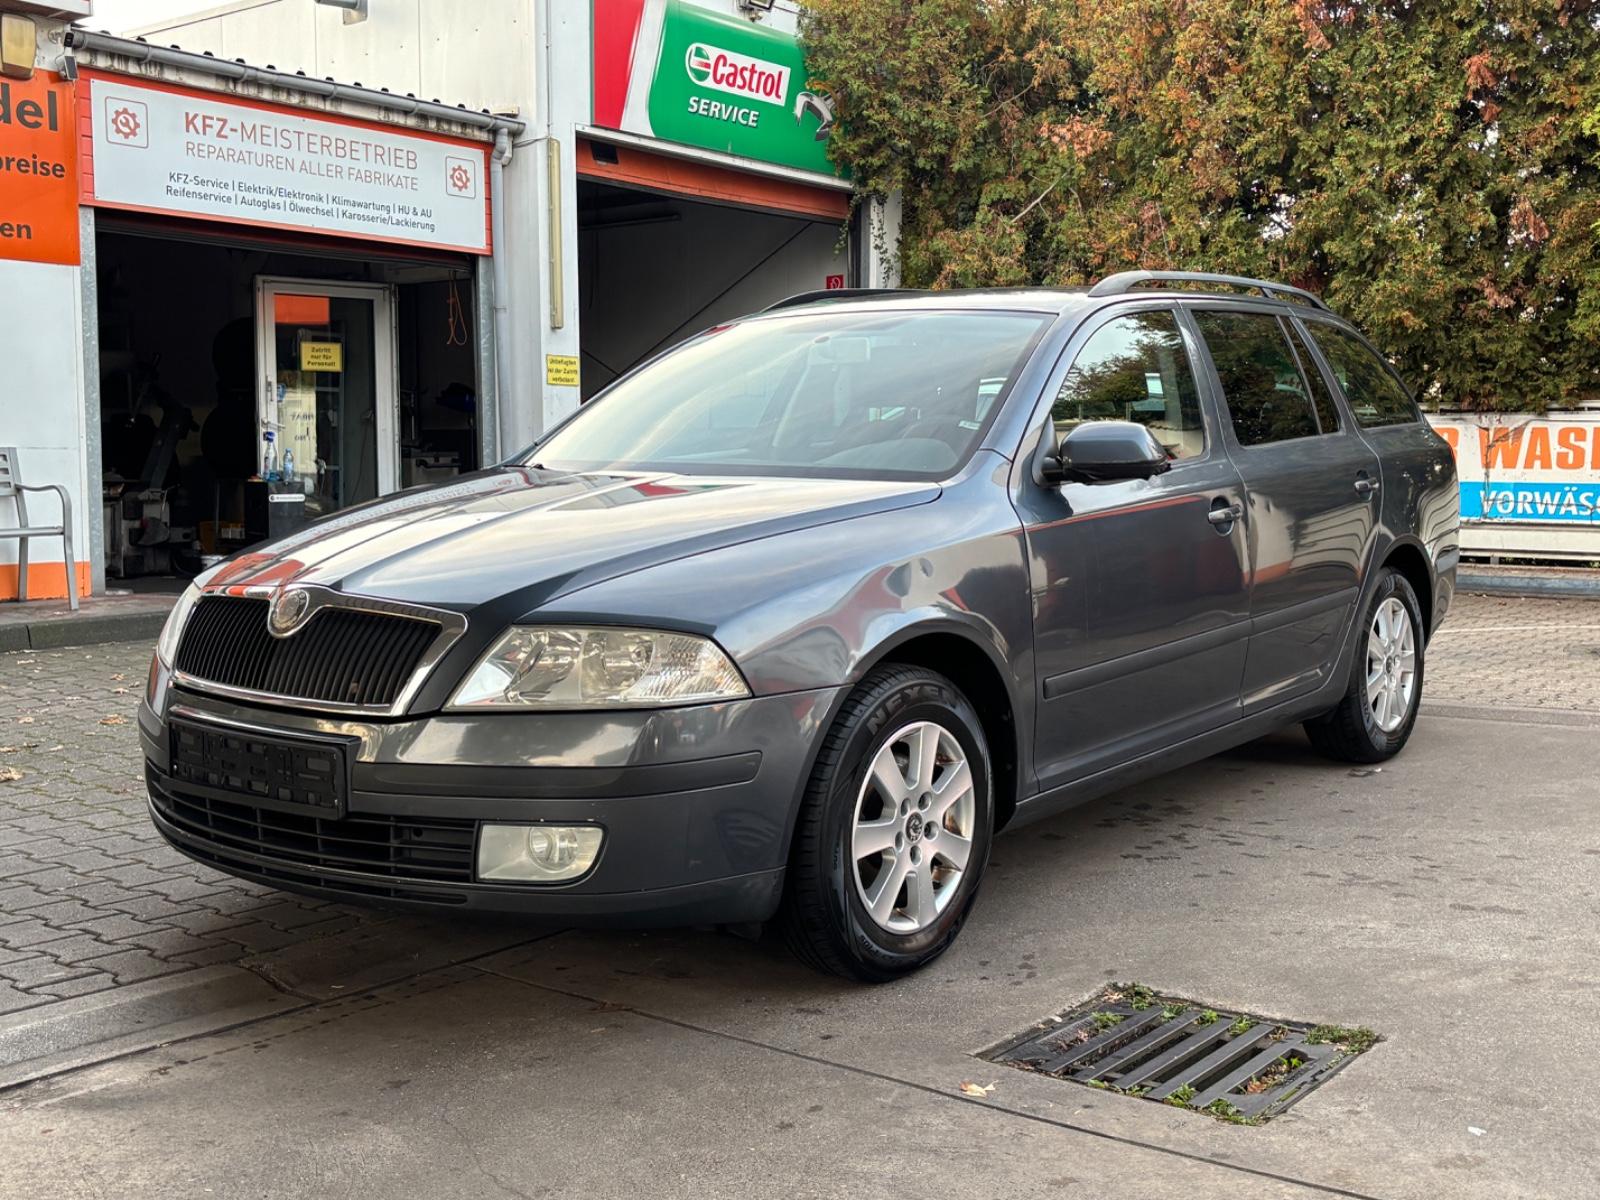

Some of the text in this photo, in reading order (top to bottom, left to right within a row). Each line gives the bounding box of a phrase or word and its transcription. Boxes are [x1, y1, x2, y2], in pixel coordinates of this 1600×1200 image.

[712, 54, 783, 100] Castrol
[687, 95, 760, 128] SERVICE
[185, 111, 418, 170] KFZ-MEISTERBETRIEB
[0, 153, 66, 179] reise
[186, 141, 419, 192] REPARATUREN ALLER FABRIKATE
[166, 184, 436, 233] Reifenservice Autoglas Ölwechsel Karosserie/Lackierung
[169, 171, 230, 190] KFZ-Service
[238, 181, 324, 204] Elektrik/Elektronik
[332, 195, 391, 215] Klimawartung
[398, 205, 410, 215] HU
[420, 208, 432, 218] AU
[1478, 426, 1600, 470] WAS
[1480, 486, 1600, 516] VORWÄS
